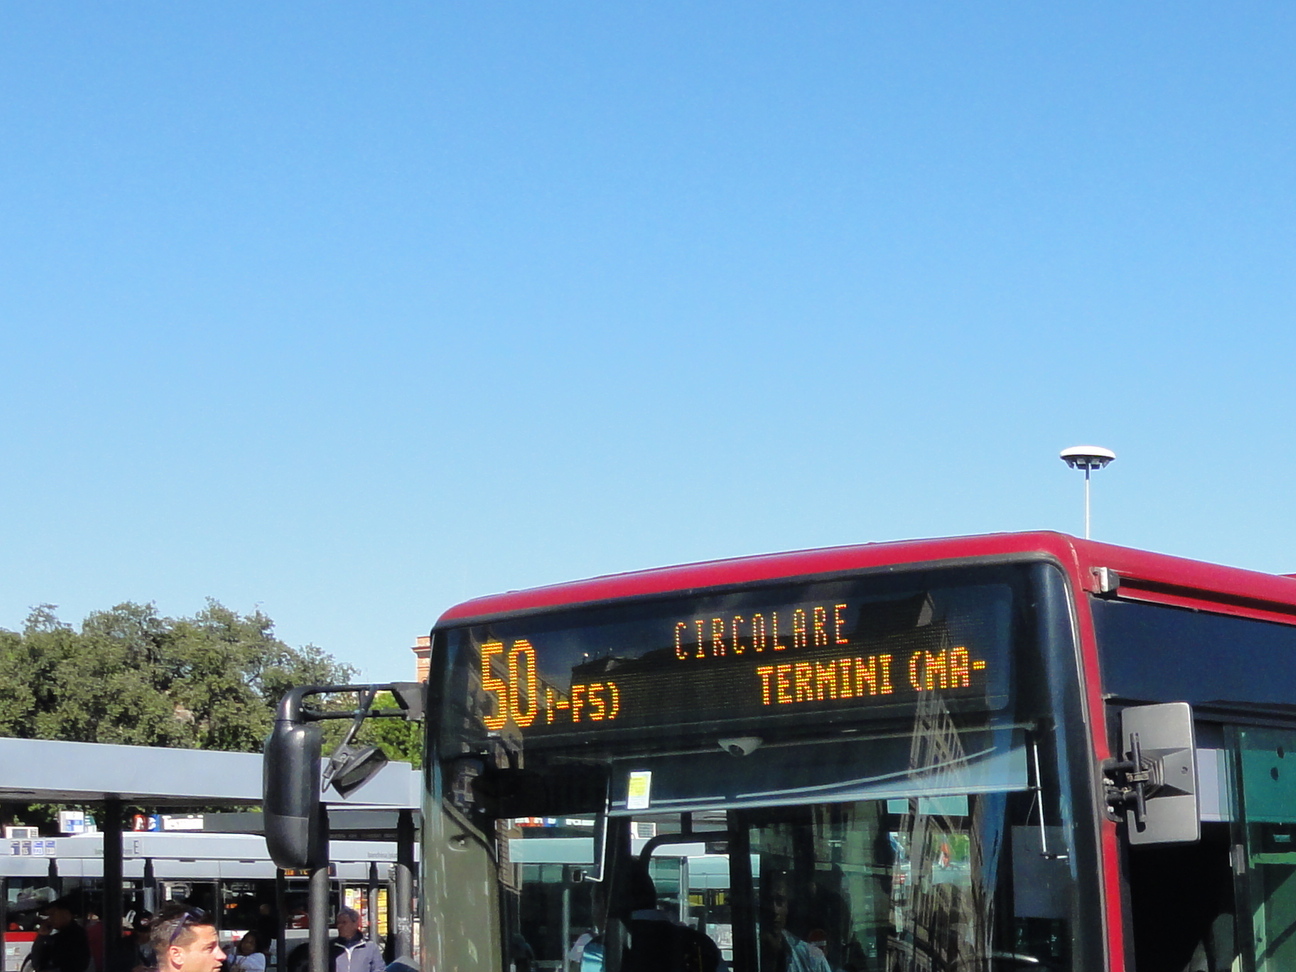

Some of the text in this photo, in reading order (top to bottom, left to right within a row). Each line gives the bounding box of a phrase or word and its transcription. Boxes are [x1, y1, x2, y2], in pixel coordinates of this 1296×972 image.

[674, 604, 849, 660] CIRCOLARE
[480, 638, 538, 731] 50
[756, 653, 894, 706] TERMINI
